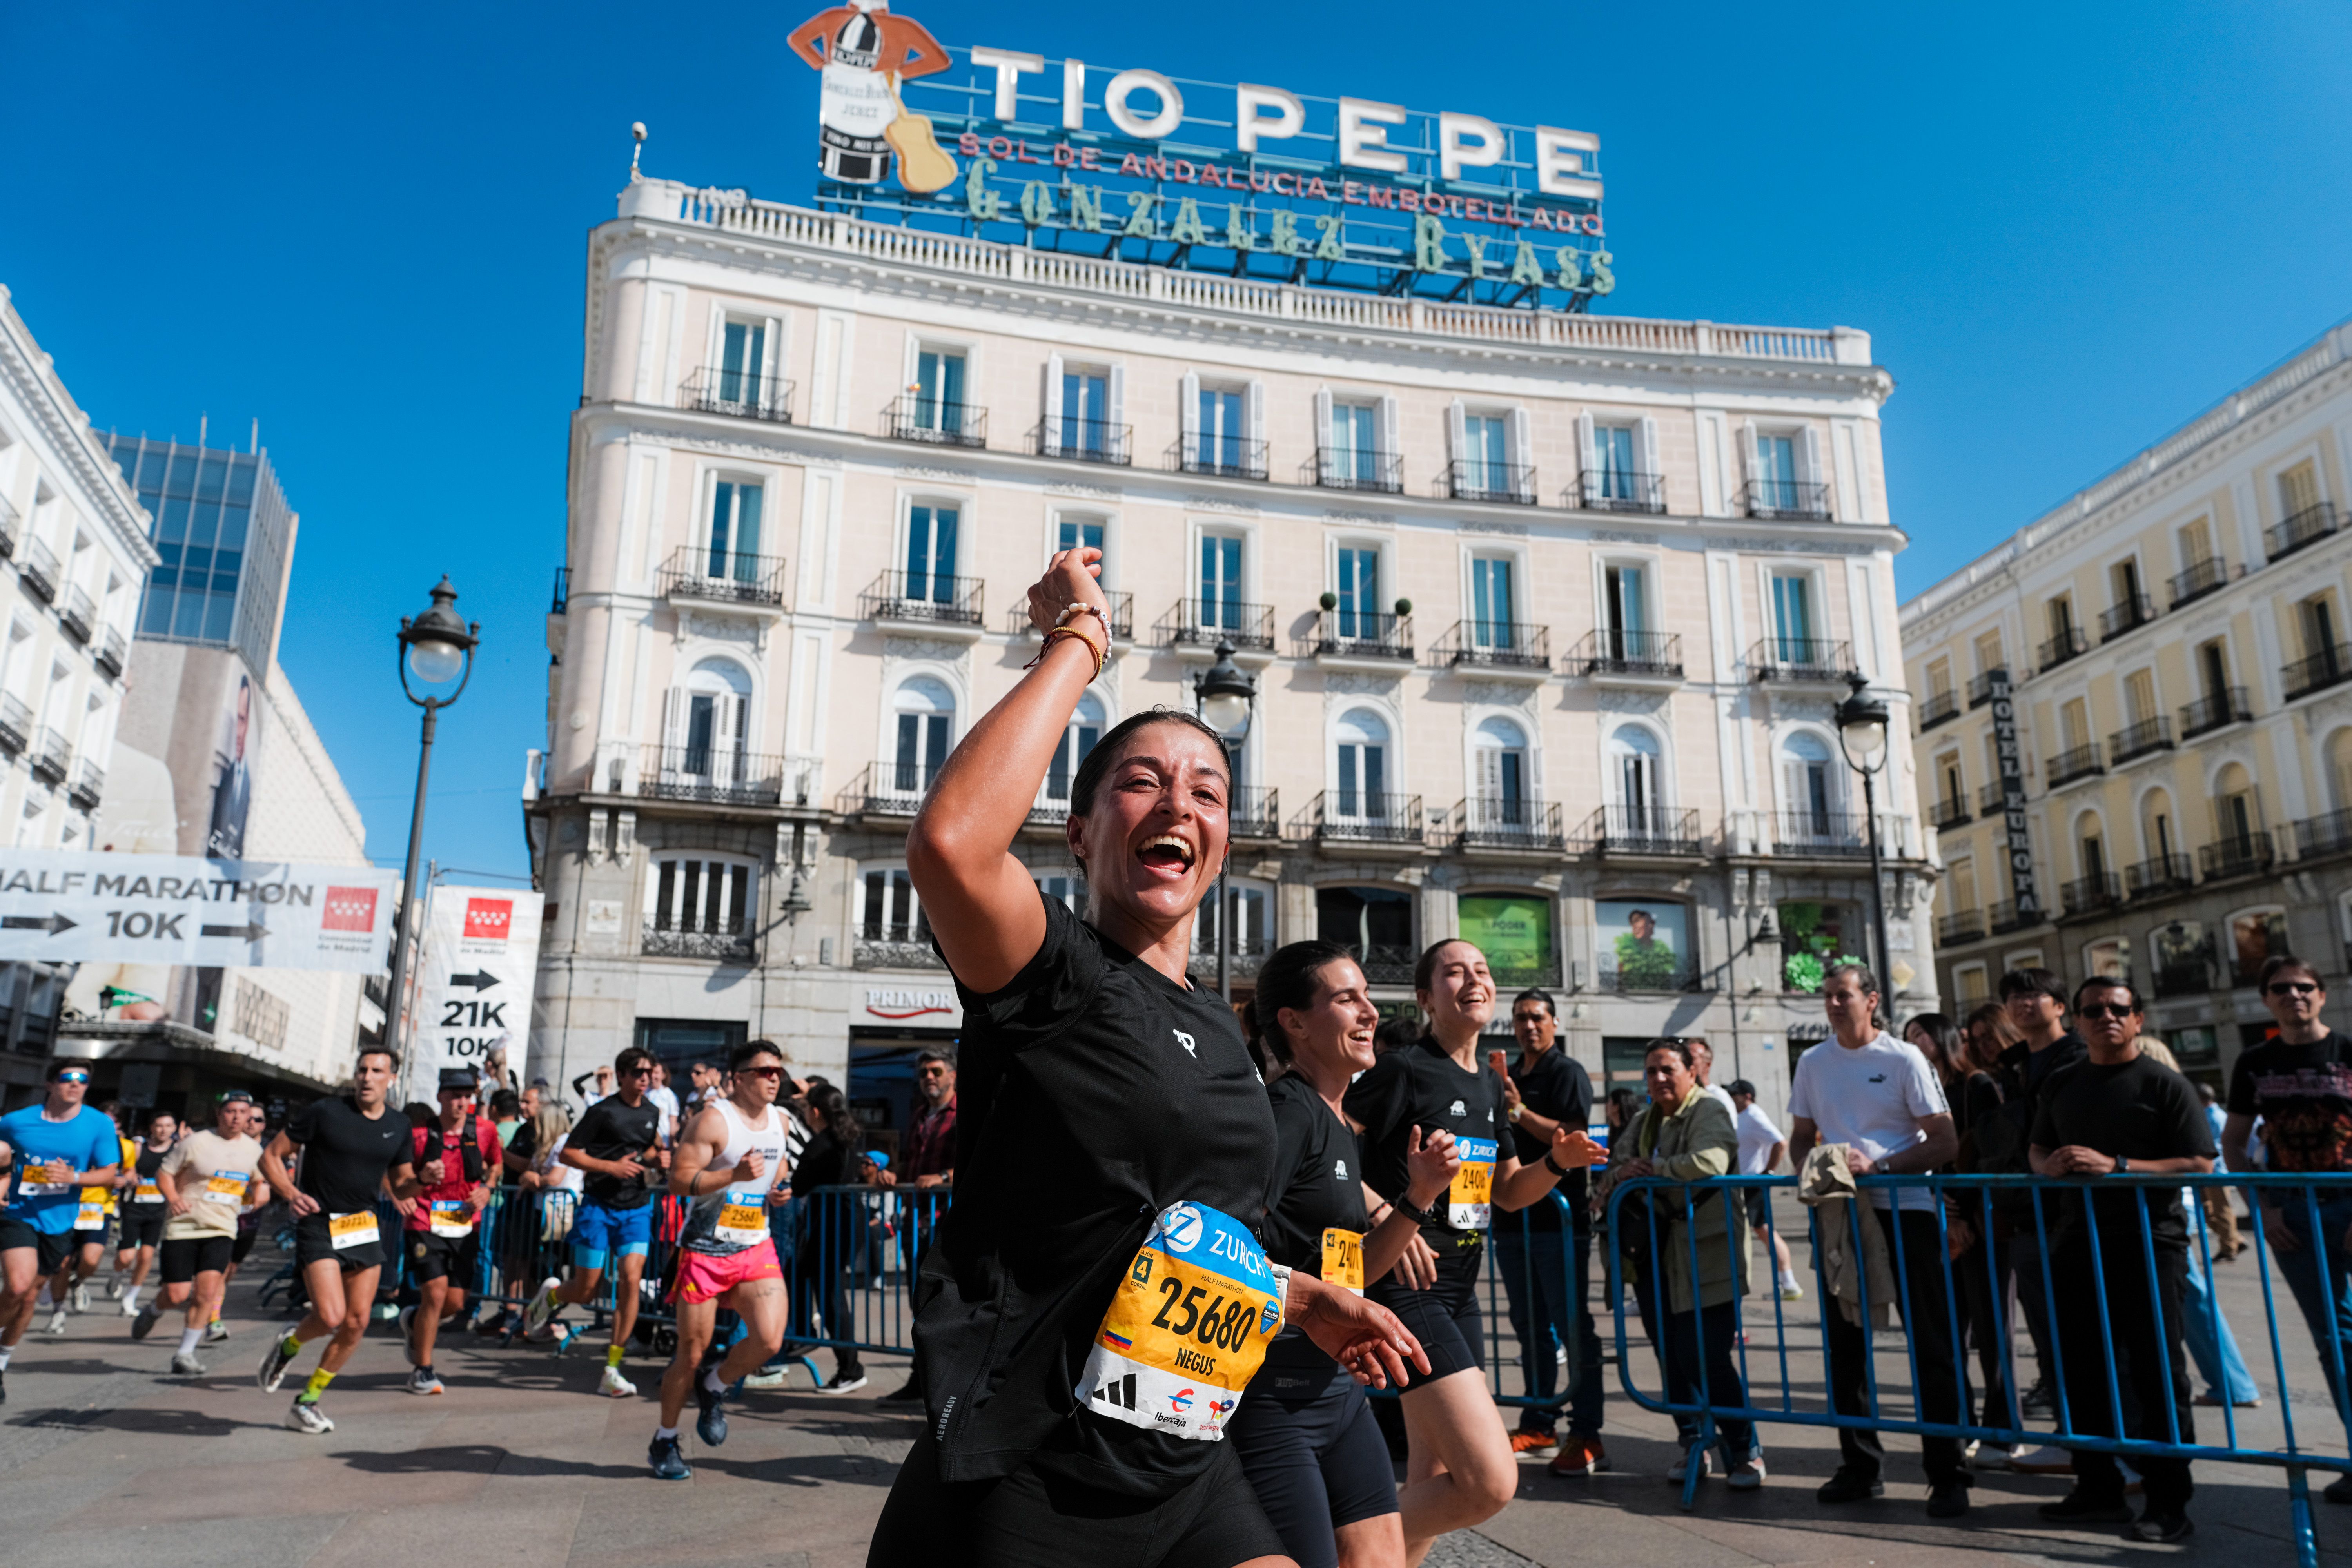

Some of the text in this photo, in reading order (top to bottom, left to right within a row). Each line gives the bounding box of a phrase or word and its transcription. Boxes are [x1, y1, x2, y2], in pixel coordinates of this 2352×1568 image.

[971, 45, 1604, 200] TIO PEPE
[959, 132, 1603, 235] SOL DE ANDALUCIA EMBOTELLADO
[966, 158, 1615, 294] GONZALEZ BYASS
[1991, 681, 2020, 777] HOTEL
[2006, 791, 2034, 911] EUROPA
[94, 873, 314, 907] MARATHON
[106, 911, 188, 940] 10K
[441, 1001, 507, 1027] 21K
[866, 990, 953, 1009] PRIMOR
[446, 1038, 494, 1056] 10K
[1472, 1144, 1496, 1157] ZURICH
[1140, 1249, 1153, 1258] CAJÓN
[1209, 1229, 1266, 1278] ZURICH
[1136, 1260, 1148, 1278] 4
[1131, 1281, 1146, 1290] CORRAL
[1201, 1274, 1243, 1294] HALF MARATHON
[1151, 1277, 1256, 1353] 25680
[1174, 1347, 1216, 1376] NEGUS
[936, 1396, 957, 1441] AEROREADY
[1154, 1412, 1187, 1427] Ibercaja
